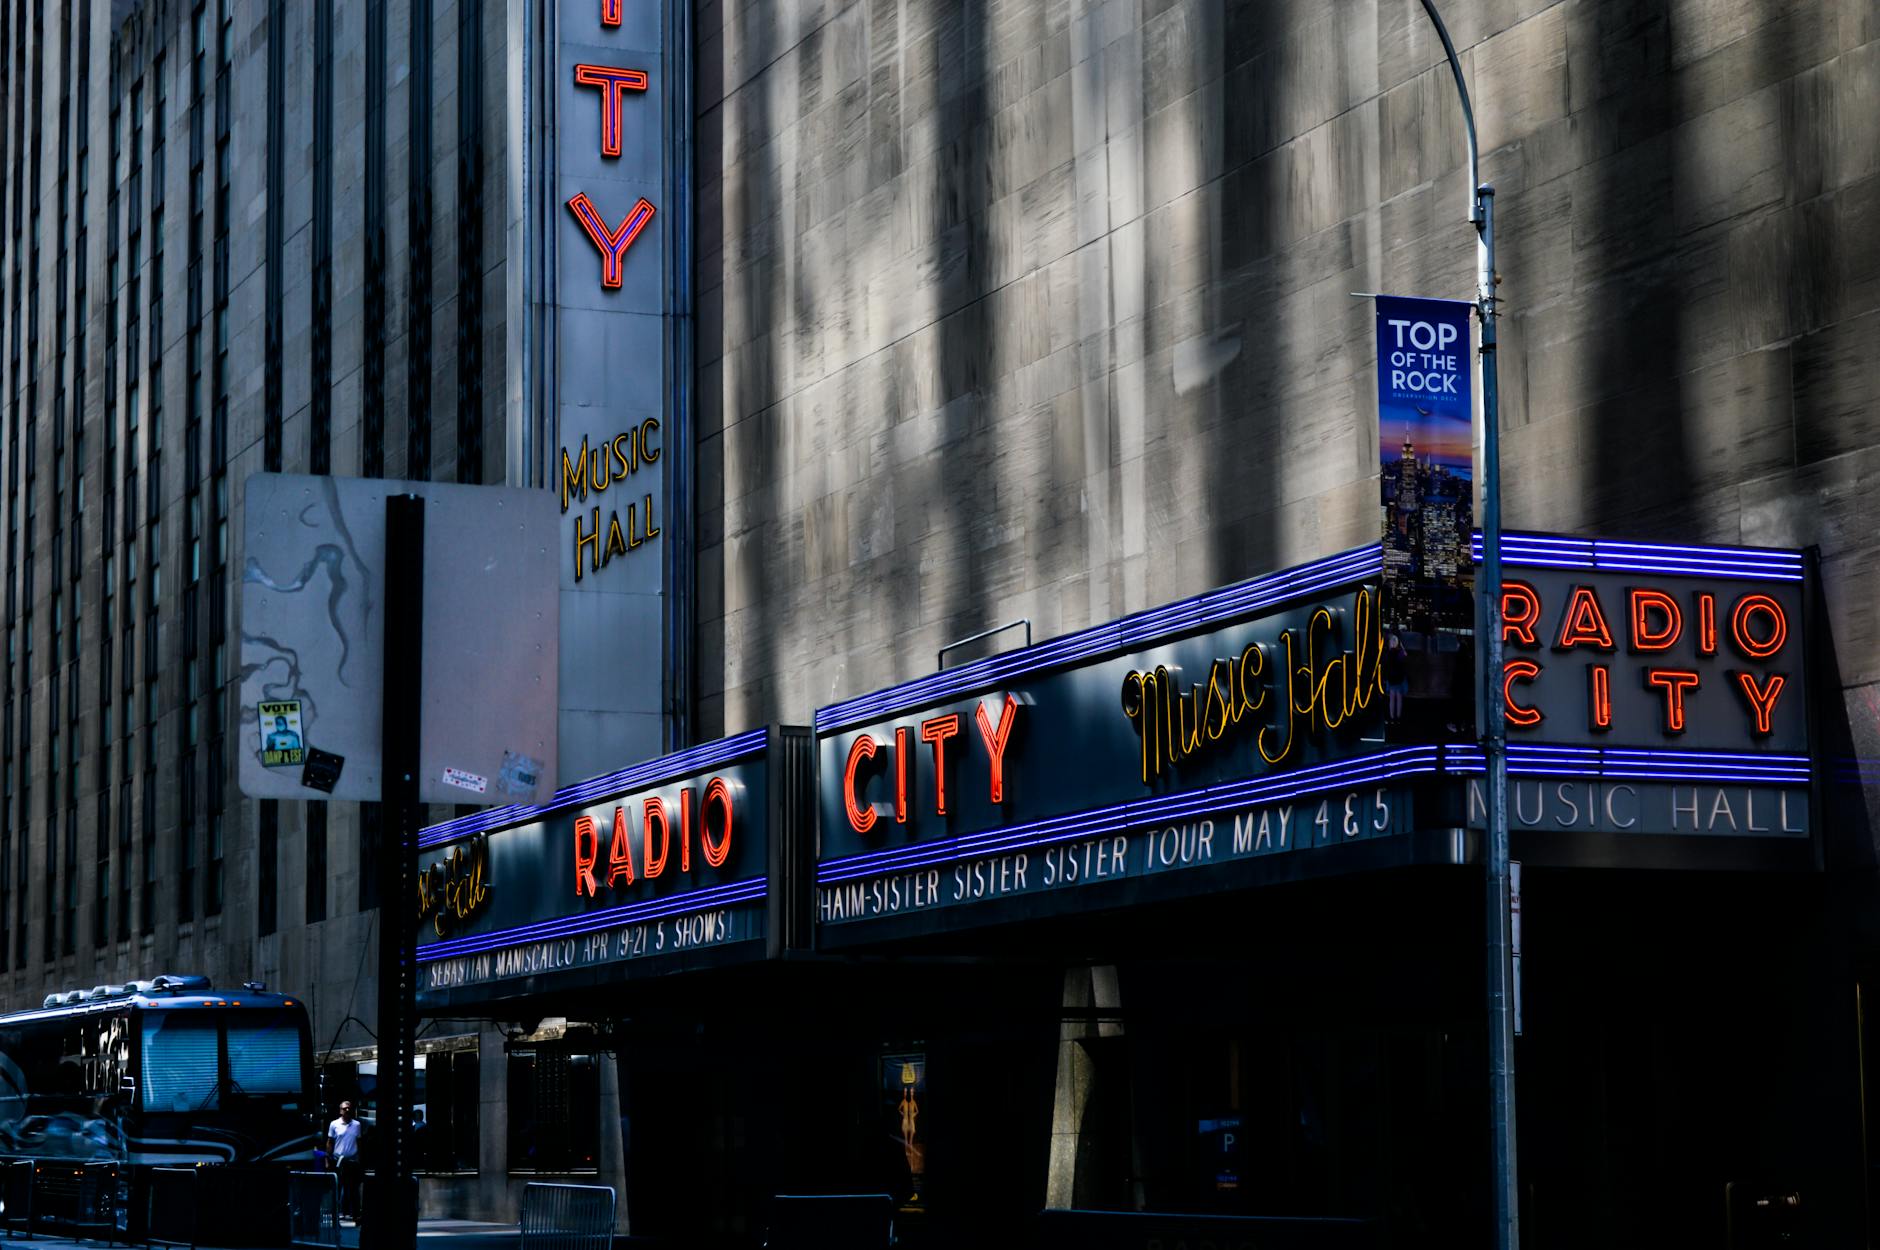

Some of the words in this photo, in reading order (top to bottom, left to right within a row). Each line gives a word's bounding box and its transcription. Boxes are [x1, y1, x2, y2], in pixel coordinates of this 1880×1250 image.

[566, 0, 657, 288] TY
[1388, 319, 1458, 351] TOP
[1390, 351, 1416, 367] OF
[1420, 353, 1457, 371] THE
[1391, 369, 1458, 394] ROCK
[561, 417, 661, 514] MUSIC
[574, 493, 661, 583] HALL
[1501, 579, 1788, 659] RADIO
[262, 703, 298, 713] VOTE
[1503, 657, 1788, 738] CITY
[843, 692, 1020, 834] CITY
[1121, 643, 1268, 786] Music
[574, 776, 734, 898] RADIO
[1469, 779, 1637, 829] MUSIC
[1671, 785, 1805, 834] HALL
[819, 868, 940, 922] HAIM-SISTER
[953, 853, 1029, 901] SISTER
[1043, 835, 1128, 886] SISTER
[1146, 819, 1215, 869] TOUR
[1232, 805, 1294, 855] MAY
[1315, 800, 1330, 839] 4
[1343, 792, 1359, 837] &
[1373, 787, 1389, 831] 5
[430, 953, 491, 988] SEBASTIAN
[495, 938, 576, 977] MANISCALCO
[582, 932, 609, 963] APR
[615, 924, 648, 957] 19-21
[655, 921, 665, 951] 5
[673, 909, 733, 950] SHOWS!
